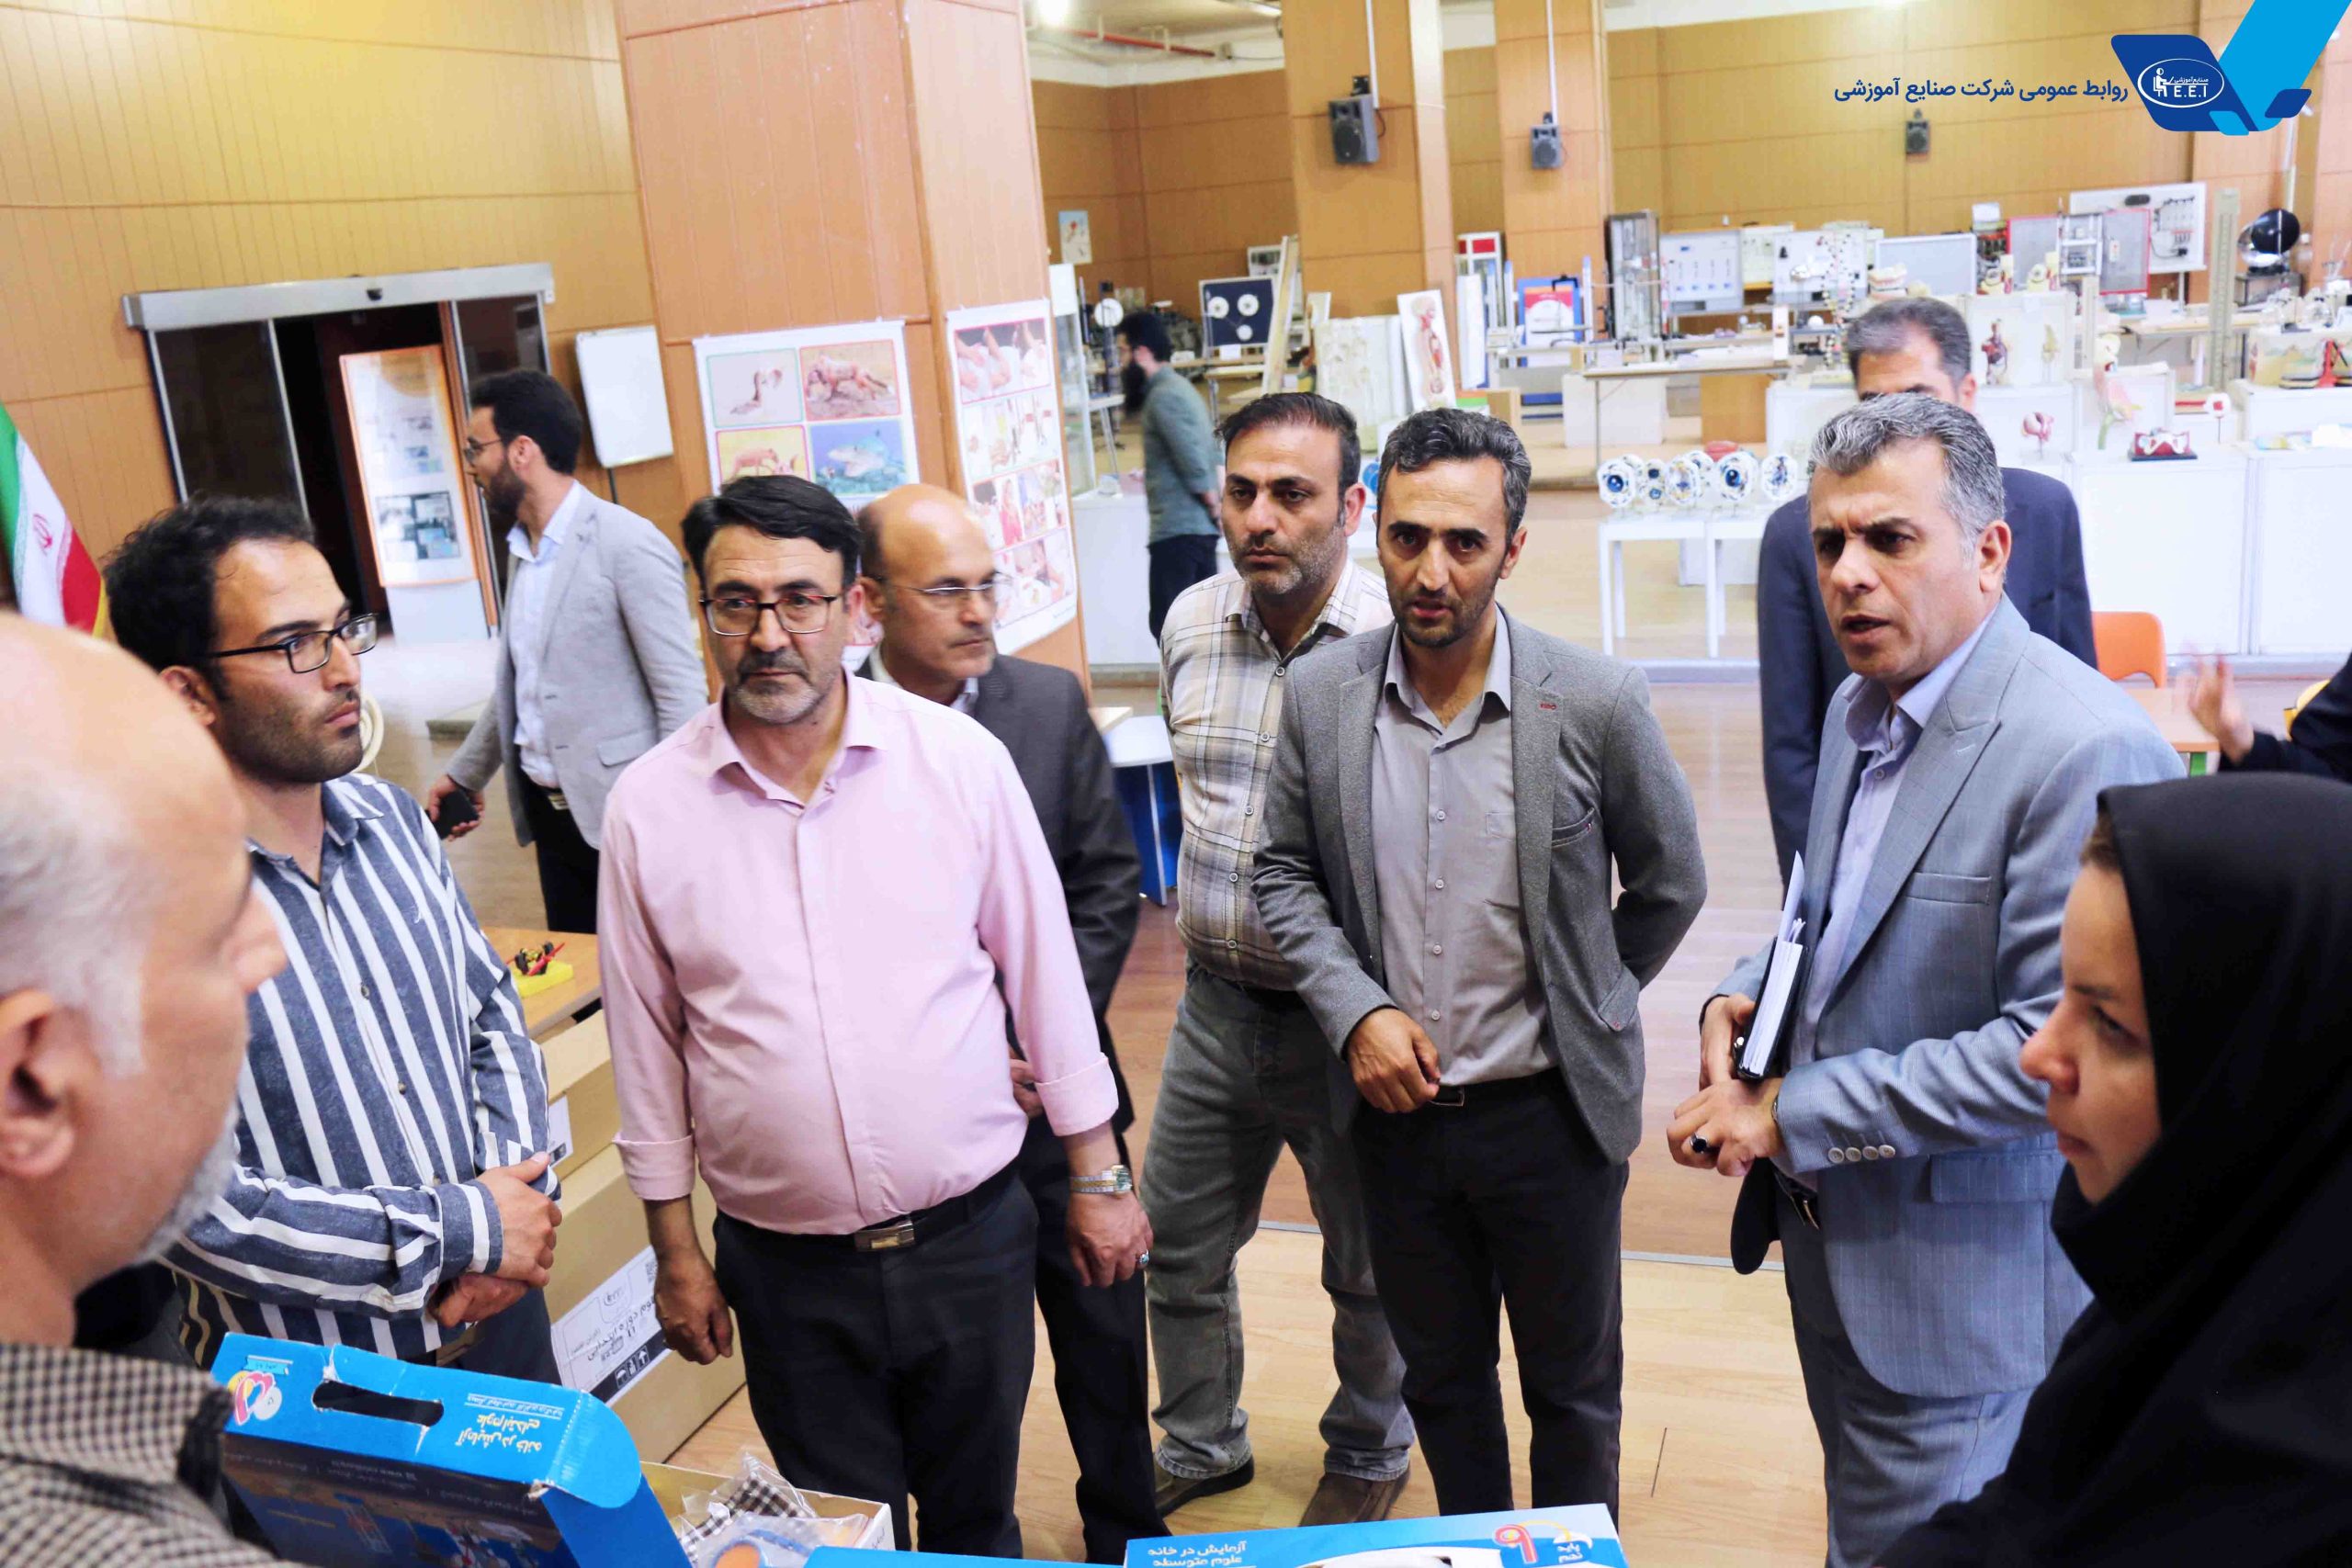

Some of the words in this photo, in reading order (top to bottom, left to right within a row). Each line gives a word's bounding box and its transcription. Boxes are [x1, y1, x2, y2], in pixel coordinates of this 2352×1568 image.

[477, 1412, 505, 1428] علوم
[502, 1416, 540, 1435] ابتدایی
[455, 1427, 503, 1449] آزمایش
[502, 1434, 517, 1448] در
[516, 1439, 542, 1454] خانه
[1148, 1546, 1178, 1556] خانه
[1180, 1546, 1195, 1557] در
[1197, 1540, 1248, 1557] آزمایش
[1152, 1557, 1208, 1568] متوسطه
[1211, 1554, 1242, 1567] علوم
